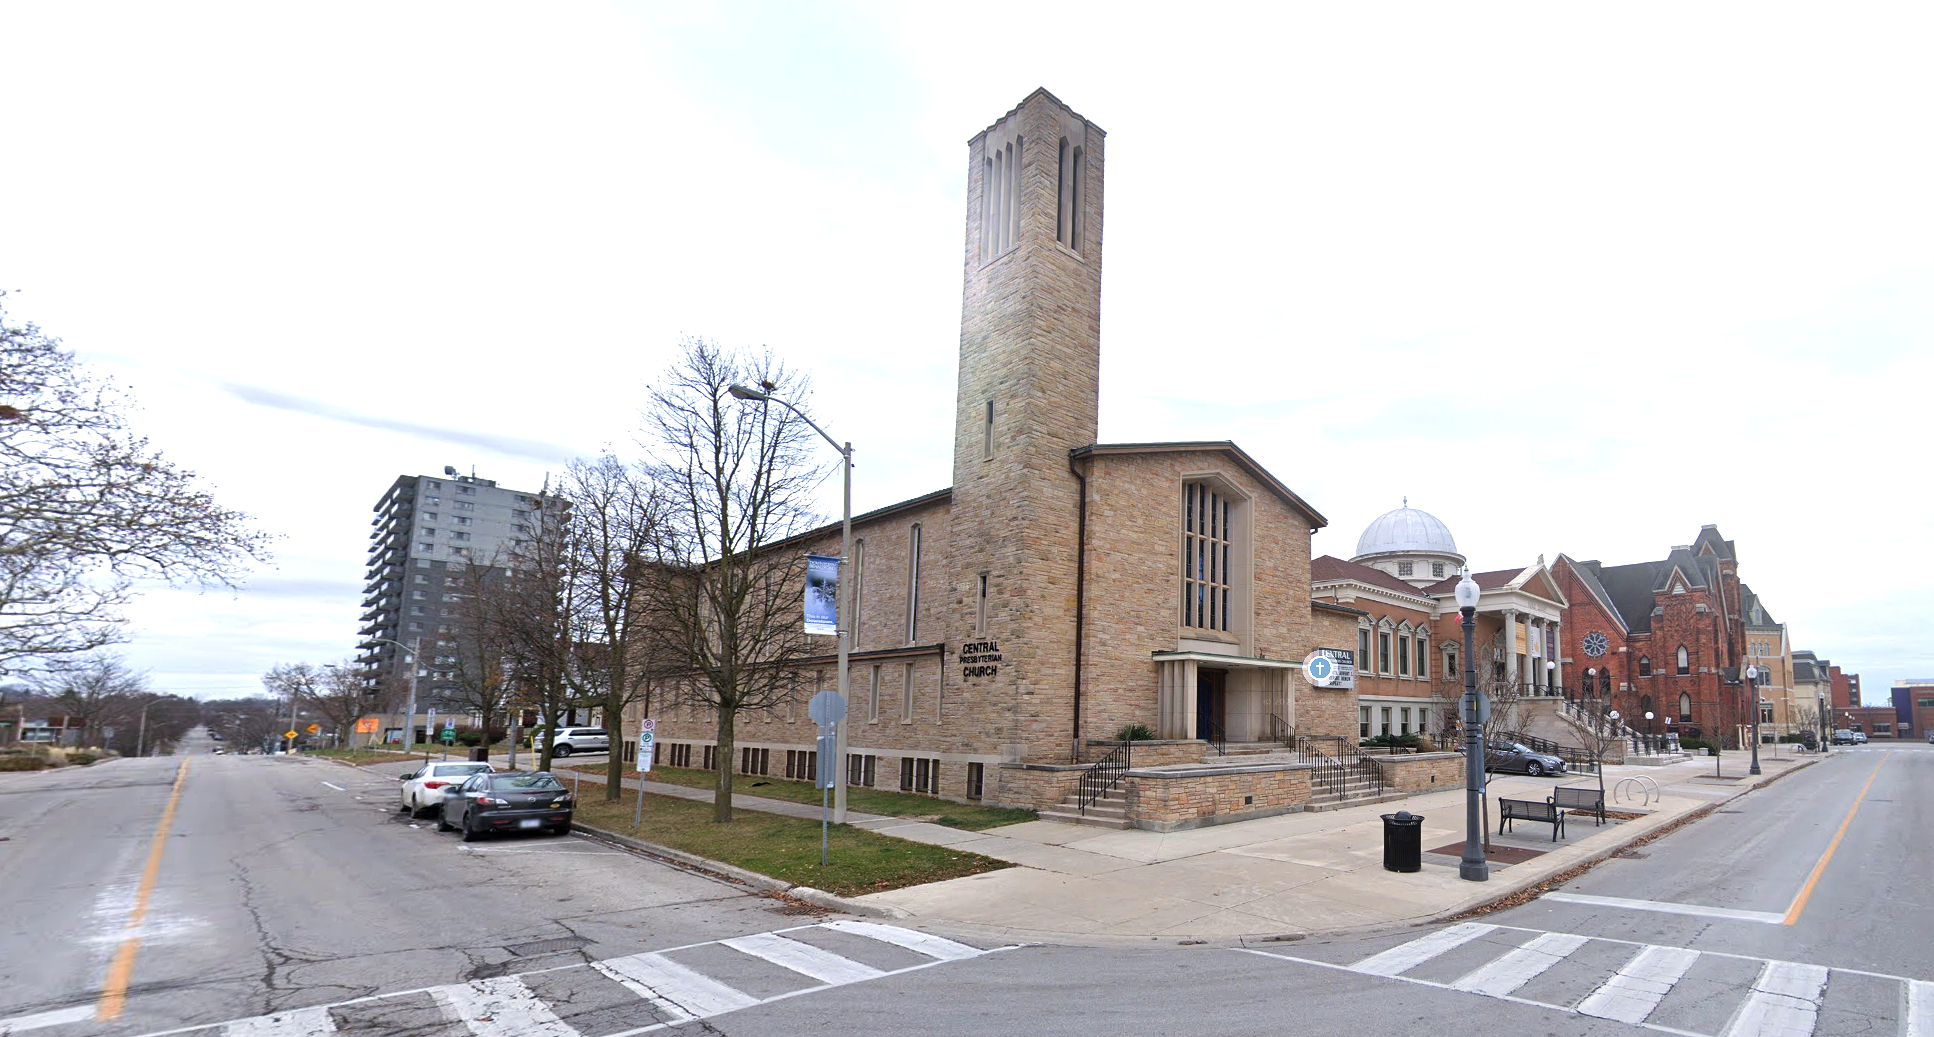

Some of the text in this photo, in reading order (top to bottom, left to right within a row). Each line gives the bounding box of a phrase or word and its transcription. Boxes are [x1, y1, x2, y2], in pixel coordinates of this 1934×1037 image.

[963, 641, 1000, 654] CENTRAL
[959, 654, 1003, 664] PRESBYTERIAN
[963, 665, 998, 678] CHURCH
